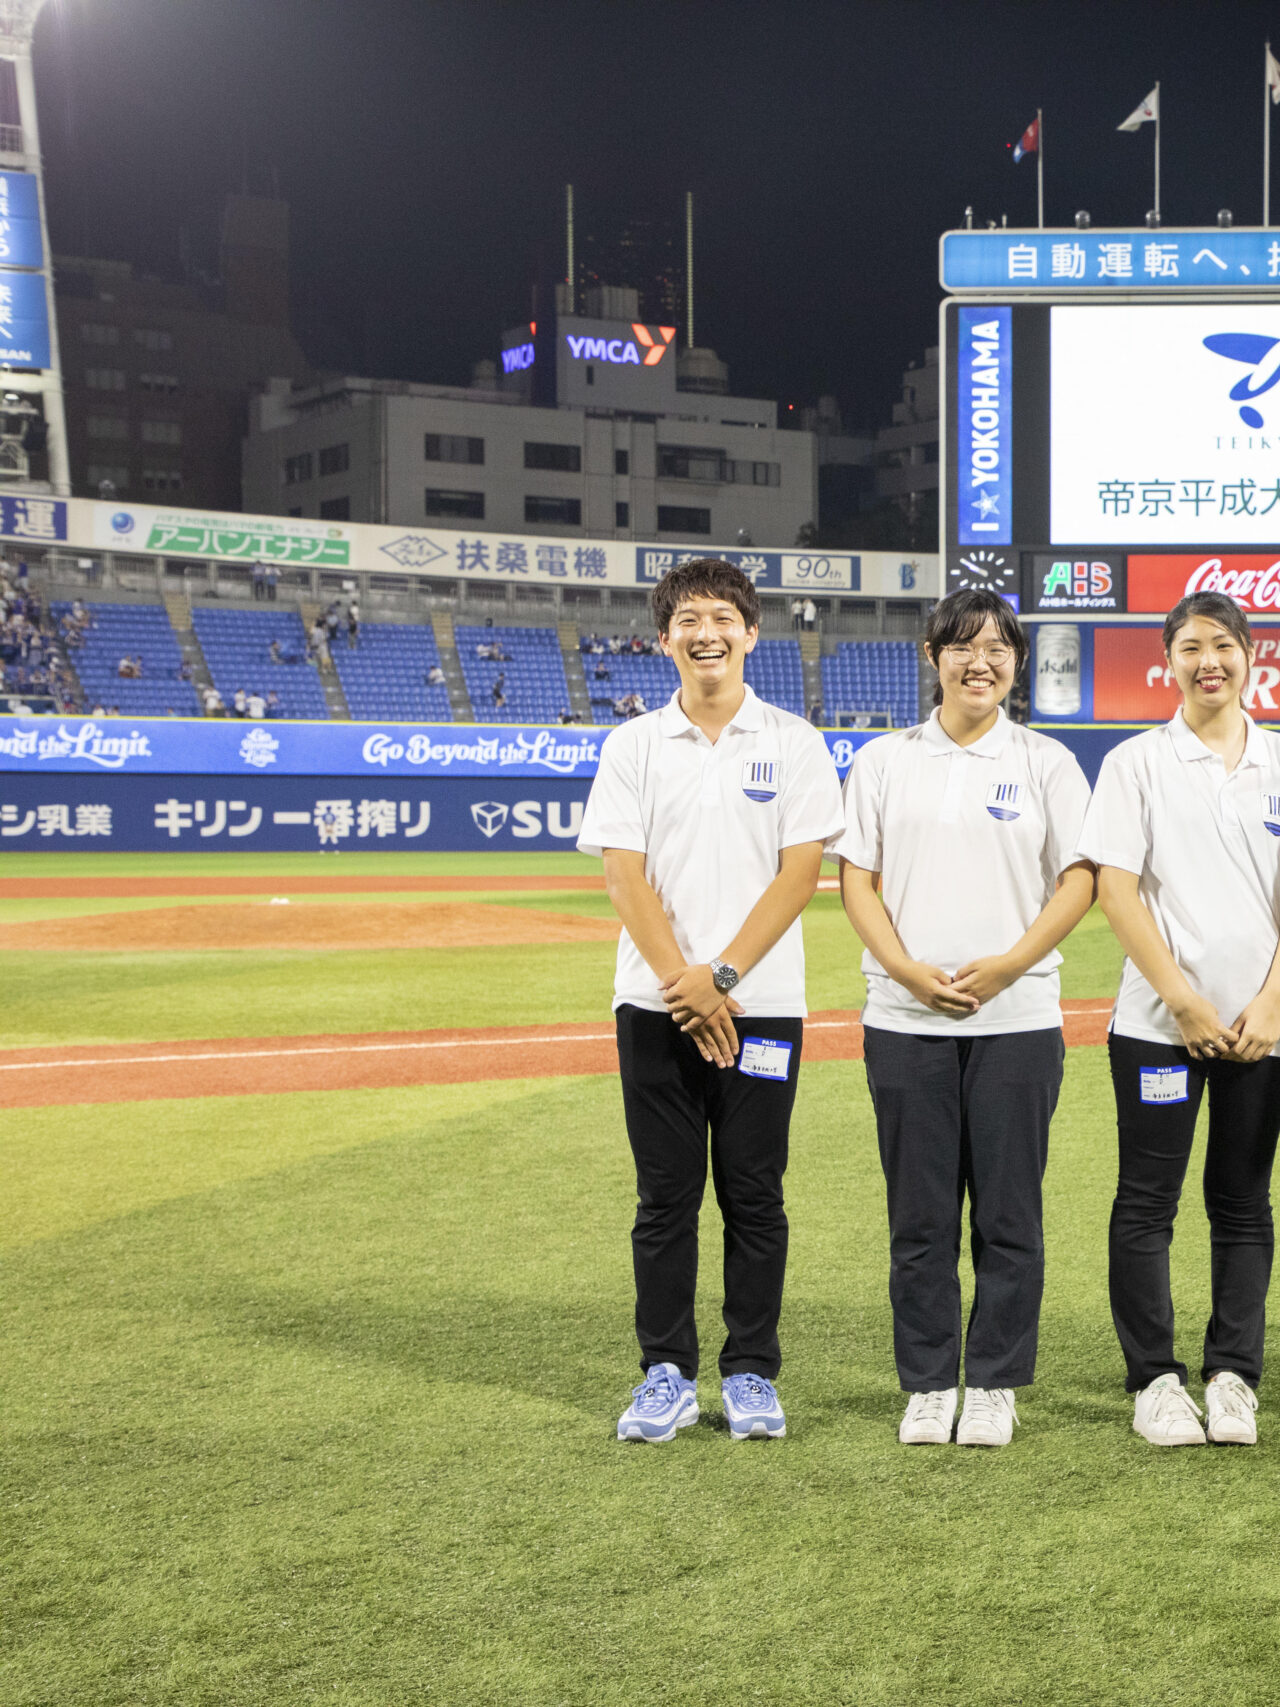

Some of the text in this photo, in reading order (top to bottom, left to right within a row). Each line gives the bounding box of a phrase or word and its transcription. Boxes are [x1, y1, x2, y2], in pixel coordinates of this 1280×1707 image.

[501, 342, 535, 374] YMCA
[566, 334, 641, 366] YMCA
[971, 319, 1000, 488] YOKOHAMA
[153, 525, 346, 561] アーバンエナジー
[456, 538, 608, 579] 扶桑電機
[644, 551, 768, 584] 昭学
[38, 735, 72, 760] the
[362, 733, 405, 767] Go
[405, 734, 499, 766] Beyond
[499, 742, 528, 766] the
[0, 804, 113, 837] シ乳業
[761, 1039, 777, 1047] PASS
